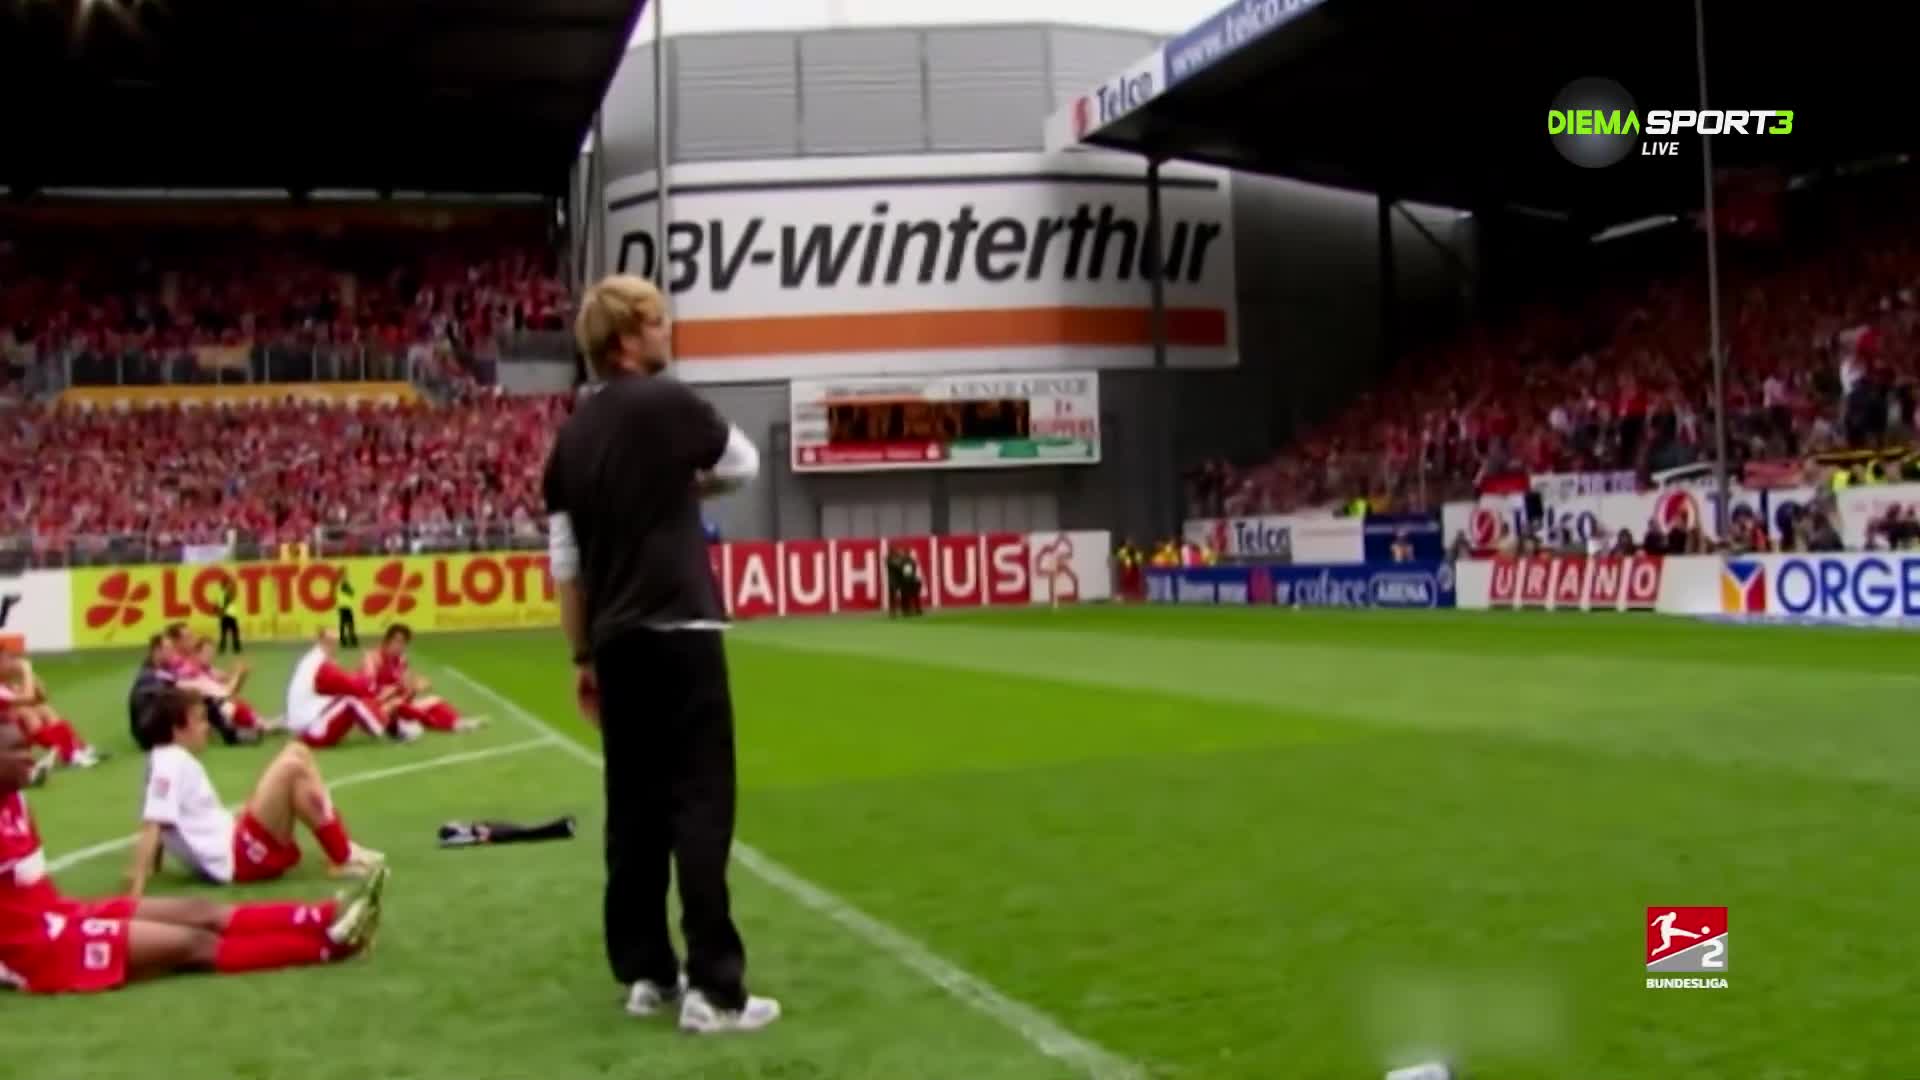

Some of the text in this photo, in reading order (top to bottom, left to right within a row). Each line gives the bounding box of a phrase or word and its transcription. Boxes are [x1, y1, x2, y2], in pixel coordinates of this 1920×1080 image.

[1097, 72, 1153, 124] Telco
[1233, 521, 1291, 550] Telco
[161, 565, 339, 619] LOTTO
[710, 542, 1025, 608] AUHUS
[1495, 564, 1657, 600] URANO
